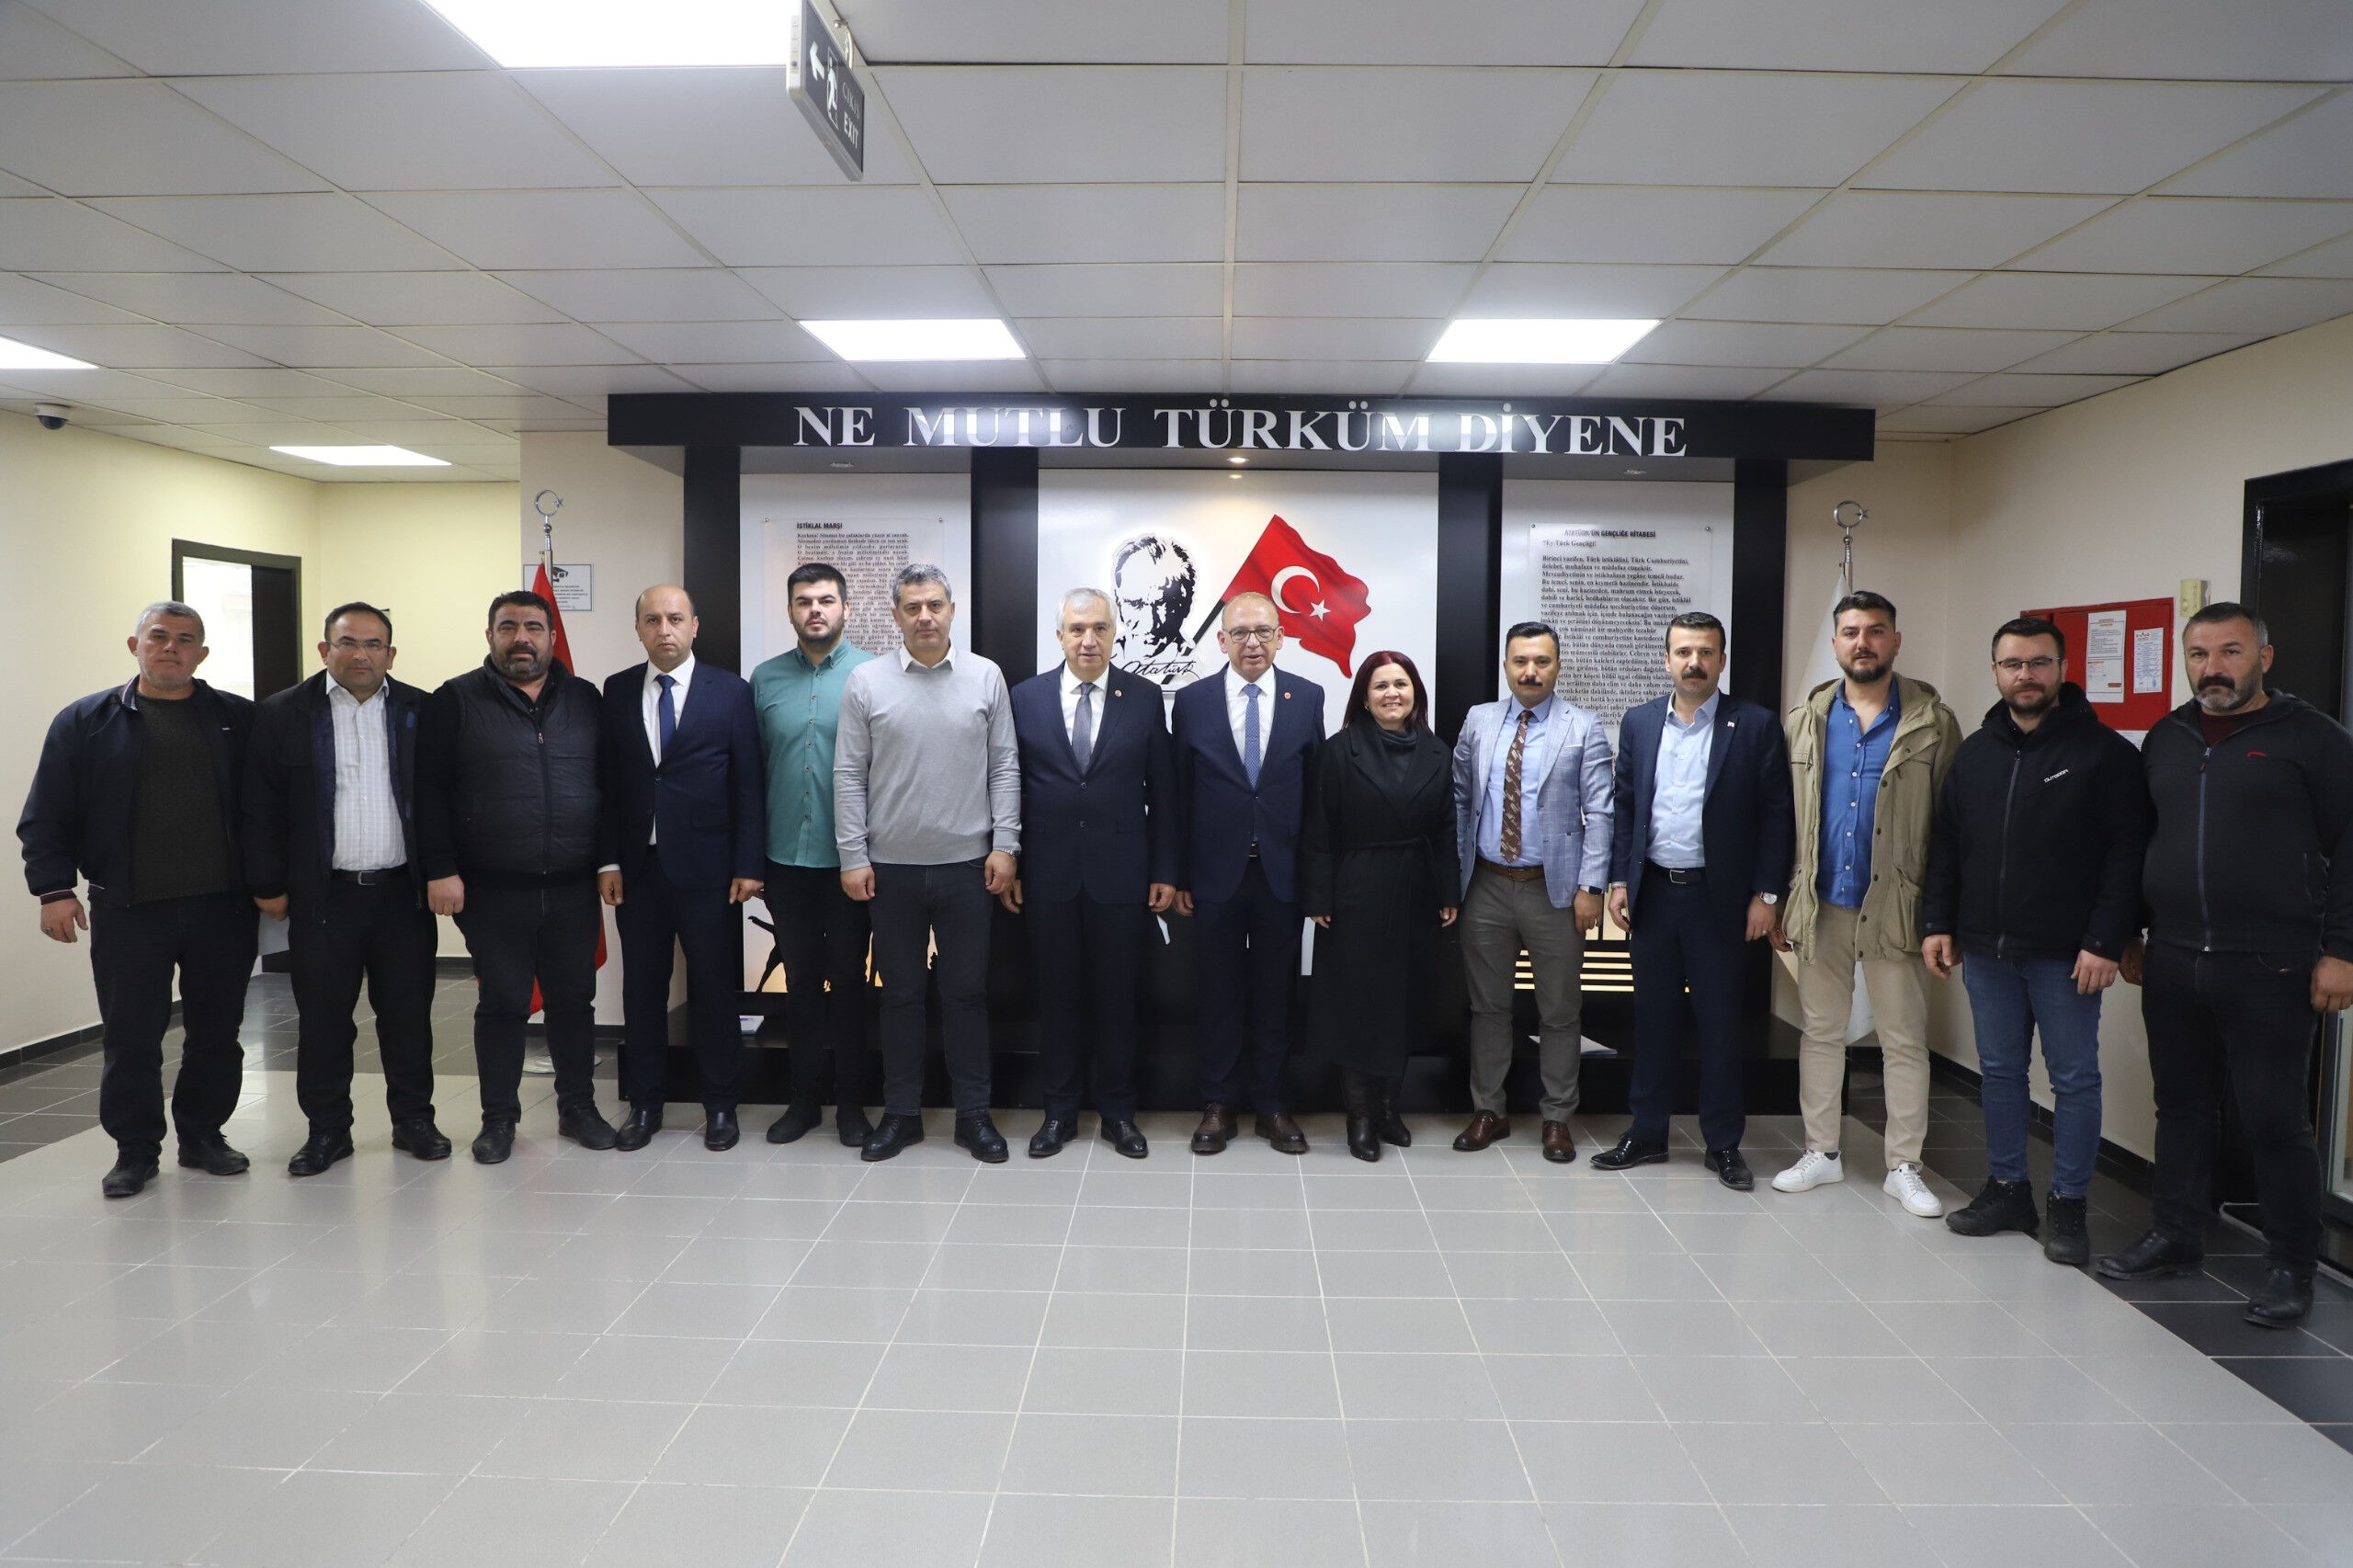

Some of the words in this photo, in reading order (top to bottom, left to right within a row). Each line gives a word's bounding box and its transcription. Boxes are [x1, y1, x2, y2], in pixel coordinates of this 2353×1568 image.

[844, 111, 858, 149] EXIT
[793, 406, 875, 447] NE
[904, 406, 1127, 448] MUTLU
[1154, 398, 1433, 452] TÜRKÜM
[1454, 403, 1688, 457] DİYENE
